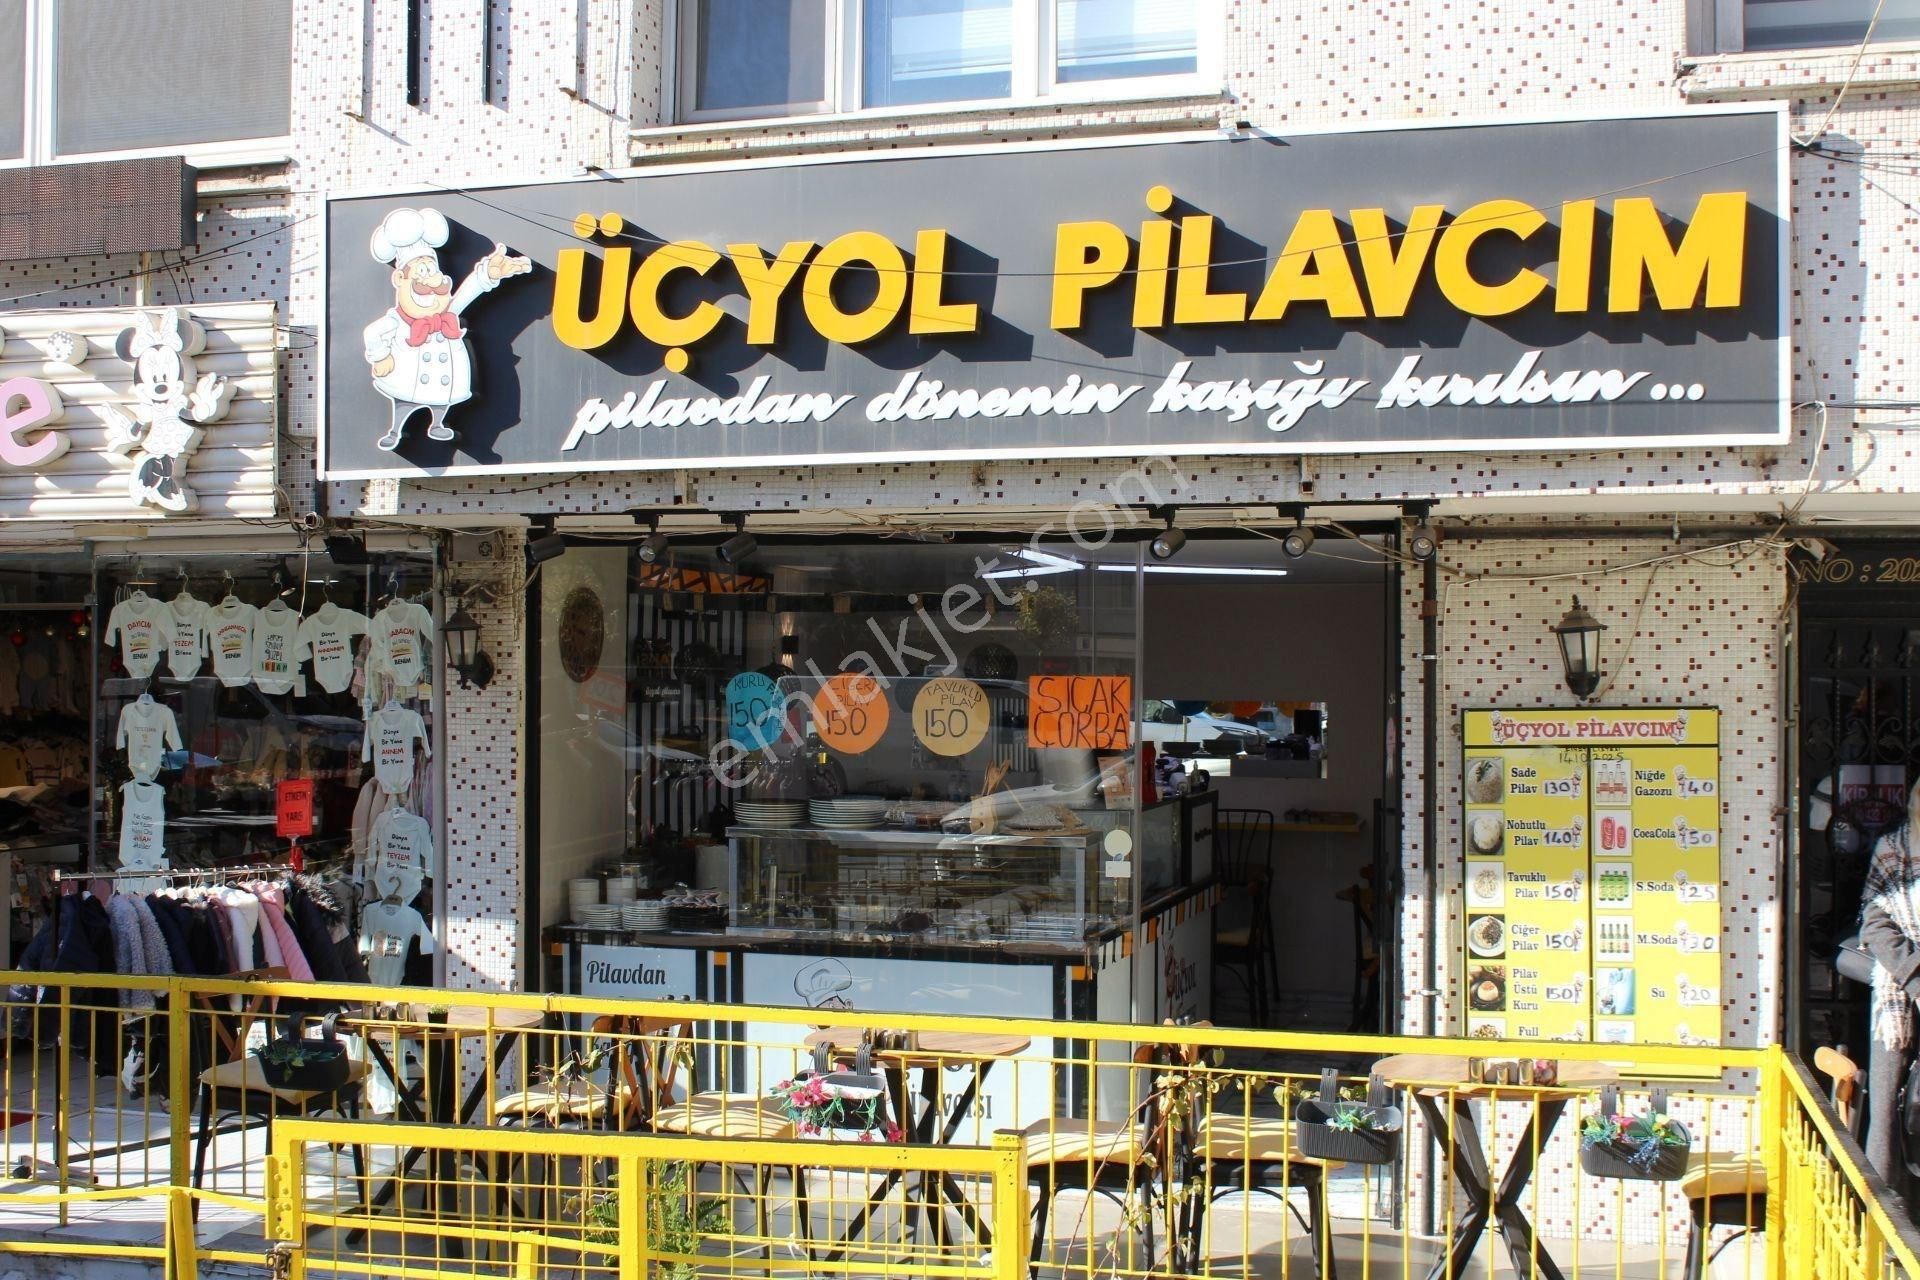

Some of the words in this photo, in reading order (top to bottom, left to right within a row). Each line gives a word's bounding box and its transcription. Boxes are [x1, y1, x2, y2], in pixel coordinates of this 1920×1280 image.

[552, 212, 979, 373] ÜÇYOL
[1050, 185, 1747, 330] PİLAVCIM
[561, 374, 857, 451] pilavdan
[866, 371, 1145, 422] dönenin
[1148, 359, 1371, 432] kaşığı
[1798, 559, 1854, 582] NO
[734, 675, 766, 691] KURU
[926, 680, 982, 703] TAVUKLU
[1037, 677, 1129, 714] SICAK
[730, 697, 769, 728] 150
[826, 707, 868, 736] 150
[925, 708, 969, 738] 150
[1033, 711, 1129, 749] ÇORBA
[1503, 719, 1571, 742] ÜÇYOL
[1576, 718, 1677, 738] PİLAVCIM
[1511, 767, 1537, 778] Sade
[1634, 770, 1666, 782] Niğde
[1510, 783, 1537, 794] Pilav
[1544, 781, 1571, 794] 130
[1634, 786, 1673, 797] Gazozu
[1687, 781, 1714, 794] 40
[1506, 819, 1546, 830] Nohutlu
[1543, 831, 1572, 844] 140
[1633, 828, 1676, 839] CocaCola
[1688, 830, 1713, 844] 50
[1514, 835, 1540, 846] Pilav
[1507, 871, 1546, 882] Tavuklu
[1514, 888, 1540, 898] Pilav
[1545, 885, 1573, 899] 150
[1636, 881, 1675, 892] S.Soda
[1689, 886, 1715, 899] 25
[1511, 924, 1540, 936] Ciğer
[1512, 940, 1539, 951] Pilav
[1545, 933, 1574, 949] 150
[1636, 934, 1678, 945] M.Soda
[1688, 936, 1714, 949] 30
[586, 960, 666, 985] Pilavdan
[1512, 968, 1538, 979] Pilav
[1513, 983, 1537, 994] Üstü
[1546, 987, 1573, 1000] 150
[1651, 987, 1666, 999] Su
[1689, 989, 1712, 1001] 20
[1512, 1000, 1539, 1011] Kuru
[1518, 1026, 1539, 1037] Full
